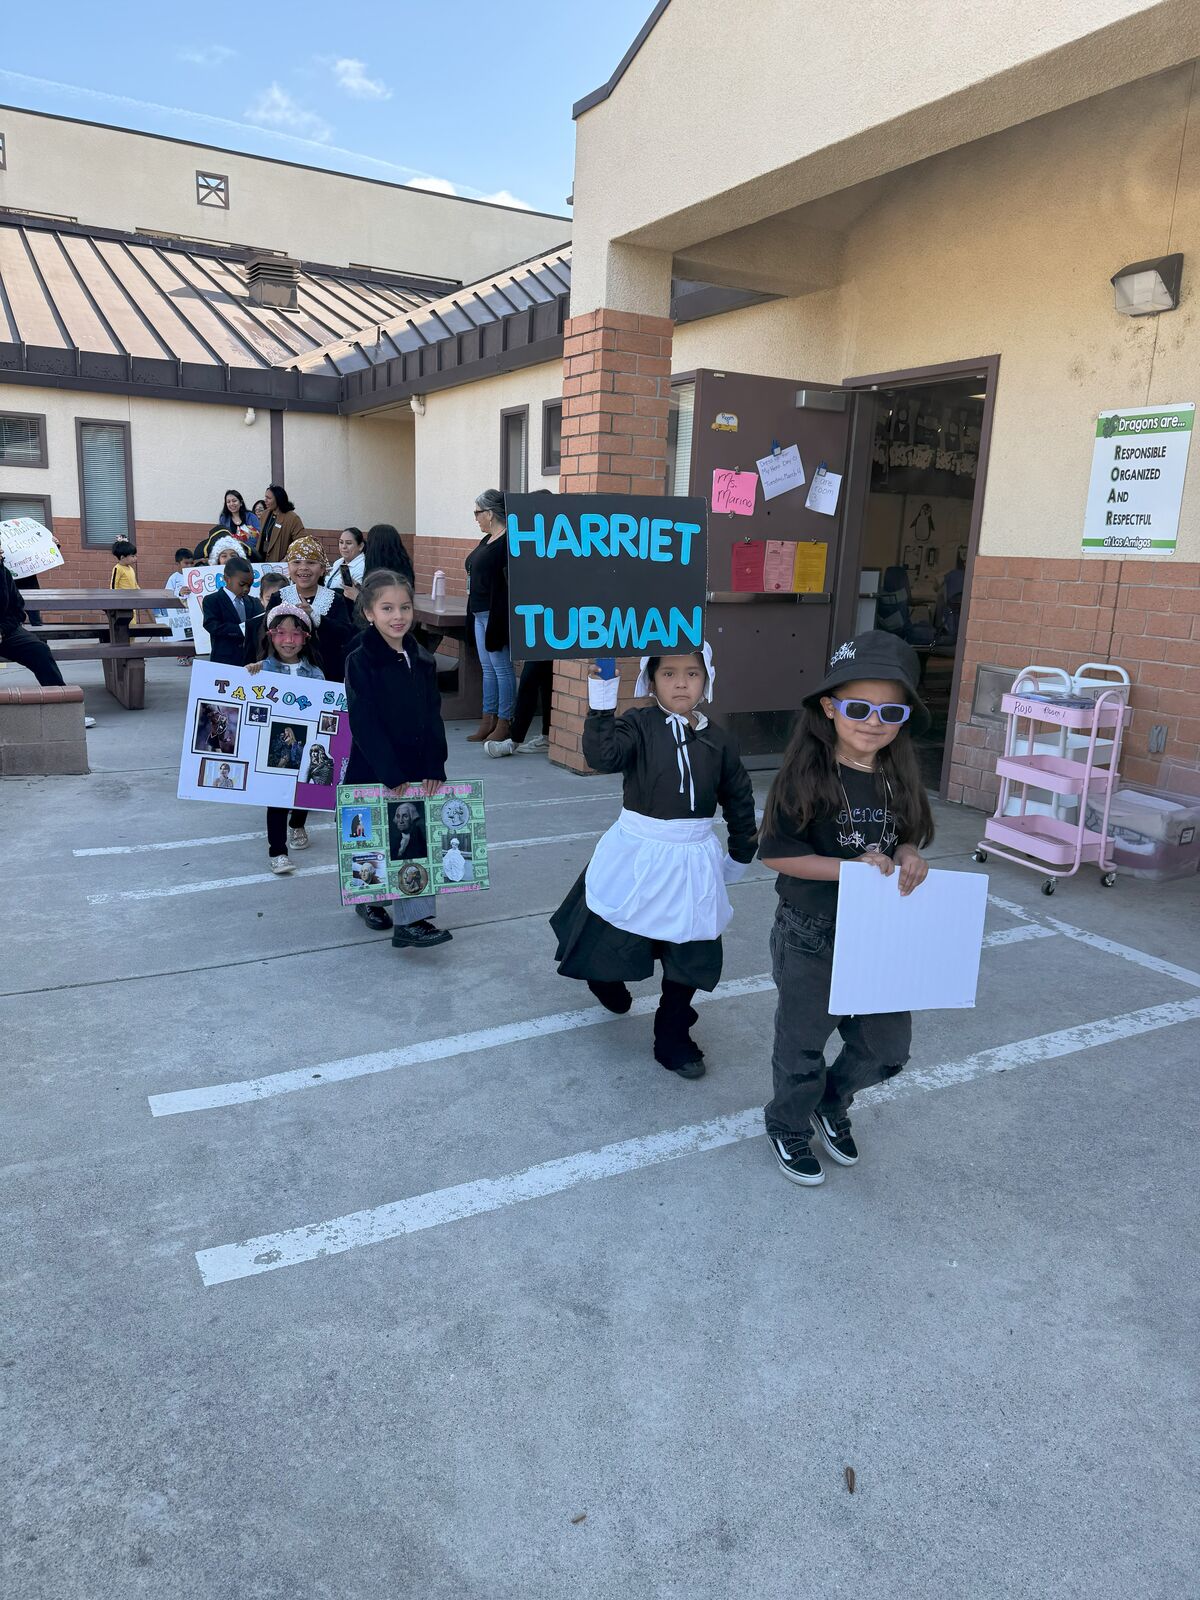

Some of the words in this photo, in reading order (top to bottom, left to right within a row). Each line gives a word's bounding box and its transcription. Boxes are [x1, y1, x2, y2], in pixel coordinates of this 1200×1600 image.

[1118, 417, 1159, 433] Dragons
[1161, 415, 1186, 428] are...
[717, 472, 737, 490] Ms.
[1111, 467, 1160, 482] ORGANIZED
[717, 489, 753, 509] Marino
[1107, 488, 1129, 503] AND
[1105, 511, 1151, 526] RESPECTFUL
[507, 513, 701, 566] HARRIET
[1103, 537, 1112, 548] at
[1112, 537, 1124, 548] Los
[1124, 536, 1152, 550] Amigos
[514, 605, 702, 650] TUBMAN
[214, 679, 312, 711] TAYLOR
